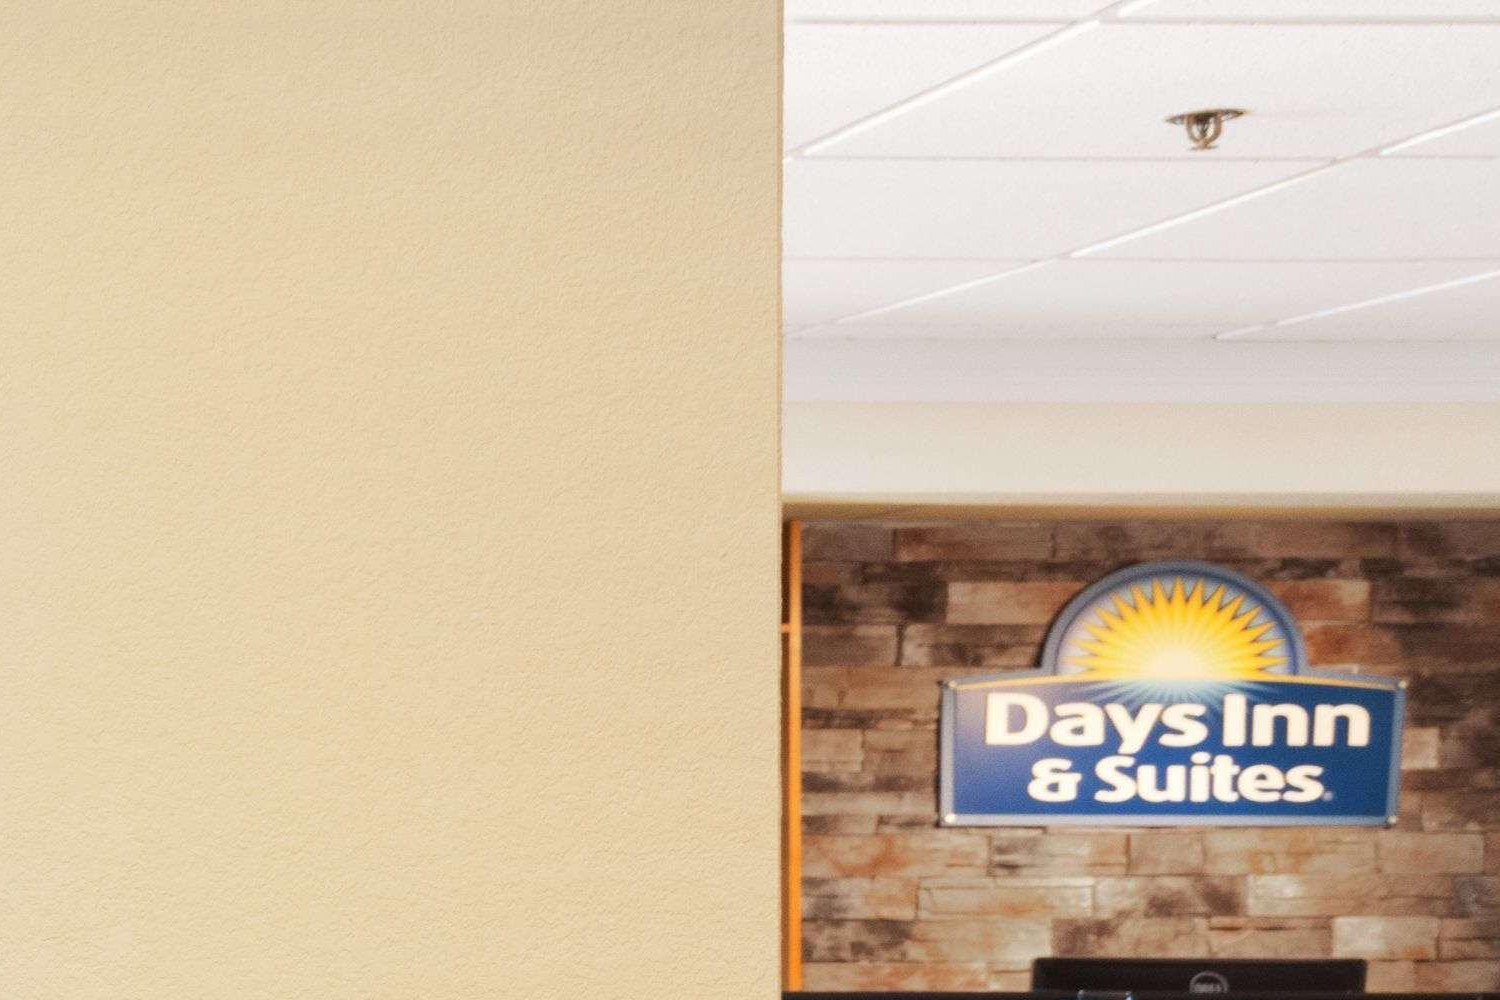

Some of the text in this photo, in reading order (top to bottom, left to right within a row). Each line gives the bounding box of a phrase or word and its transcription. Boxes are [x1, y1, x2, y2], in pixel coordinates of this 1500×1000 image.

[985, 691, 1371, 754] Days Inn
[1027, 751, 1325, 803] & Suites
